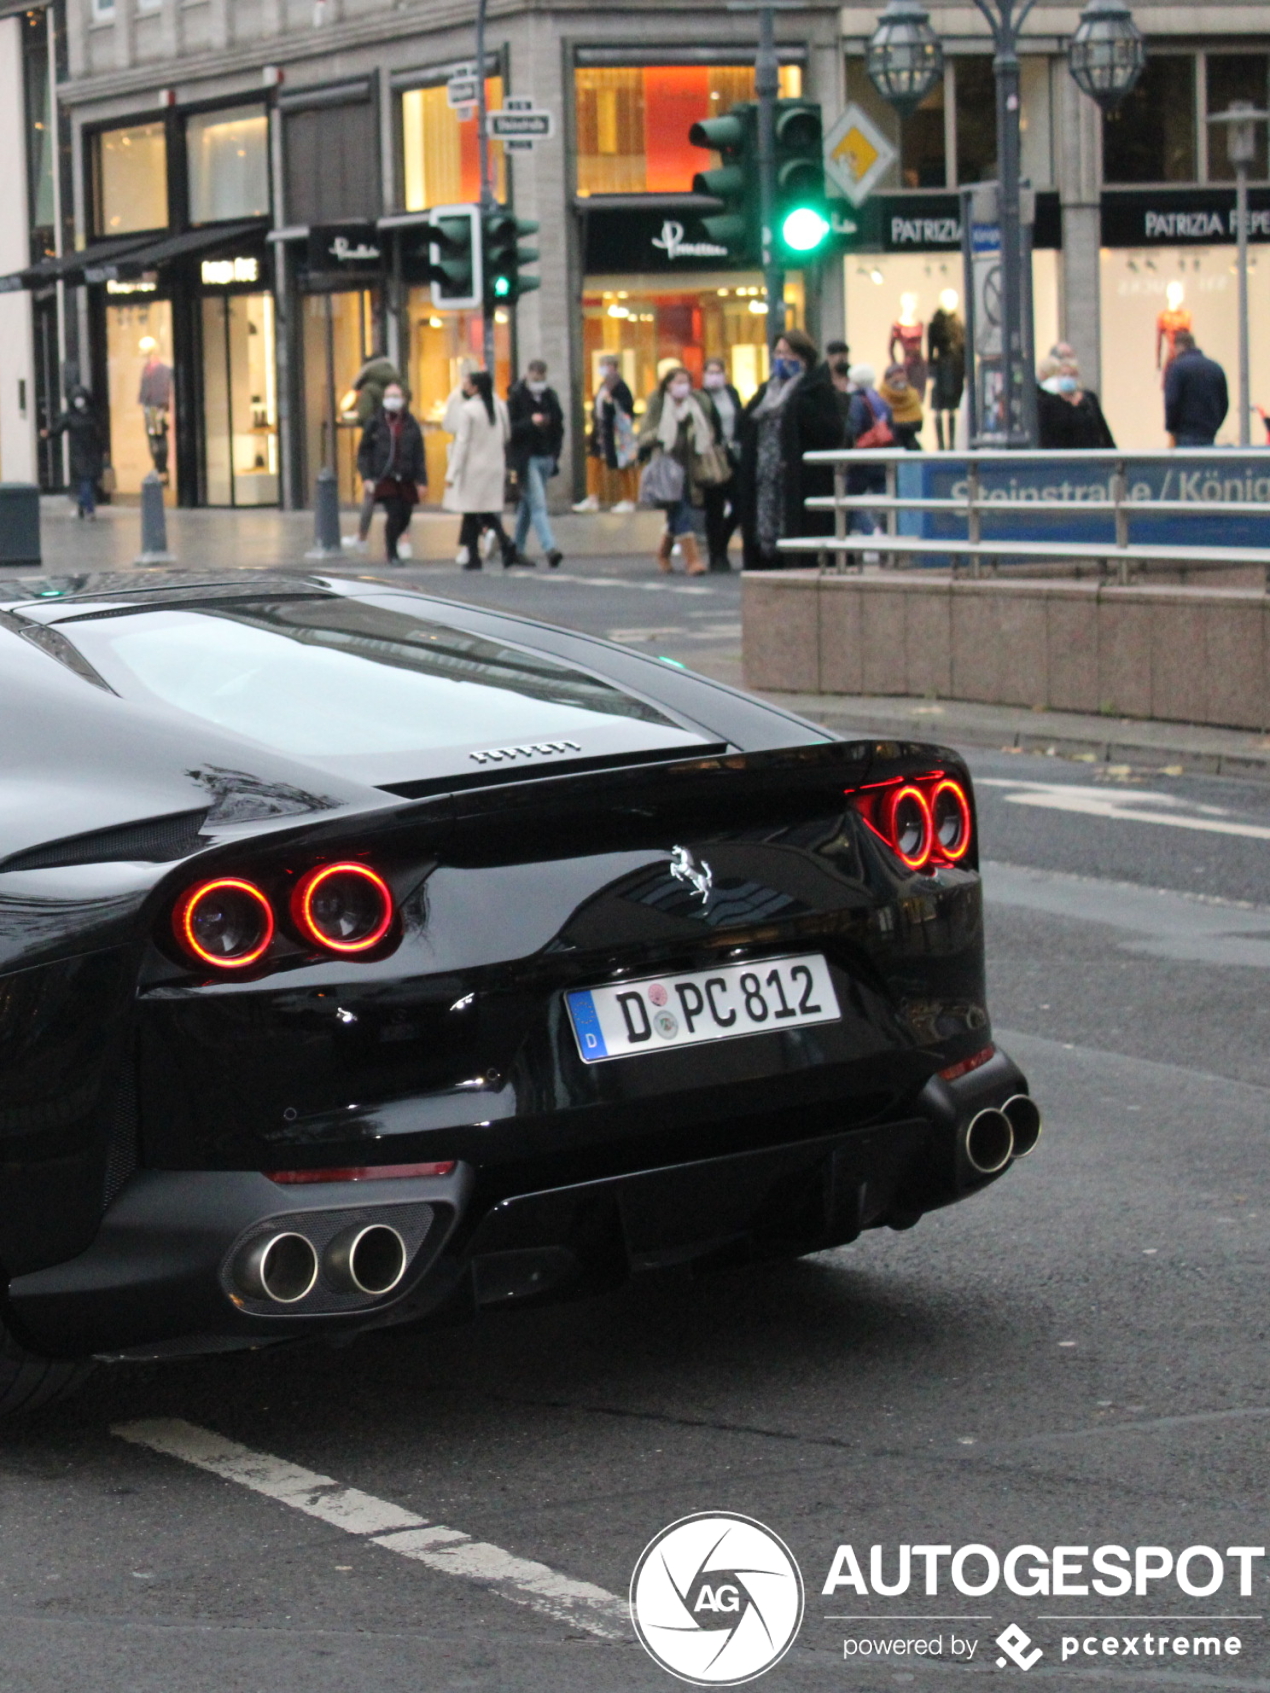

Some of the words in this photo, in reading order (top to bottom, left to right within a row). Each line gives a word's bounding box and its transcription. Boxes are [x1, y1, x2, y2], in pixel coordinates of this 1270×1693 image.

[1145, 210, 1224, 237] PATRIZIA
[585, 1033, 597, 1048] D
[616, 991, 652, 1043] D
[675, 977, 736, 1033] PC
[739, 965, 822, 1023] 812
